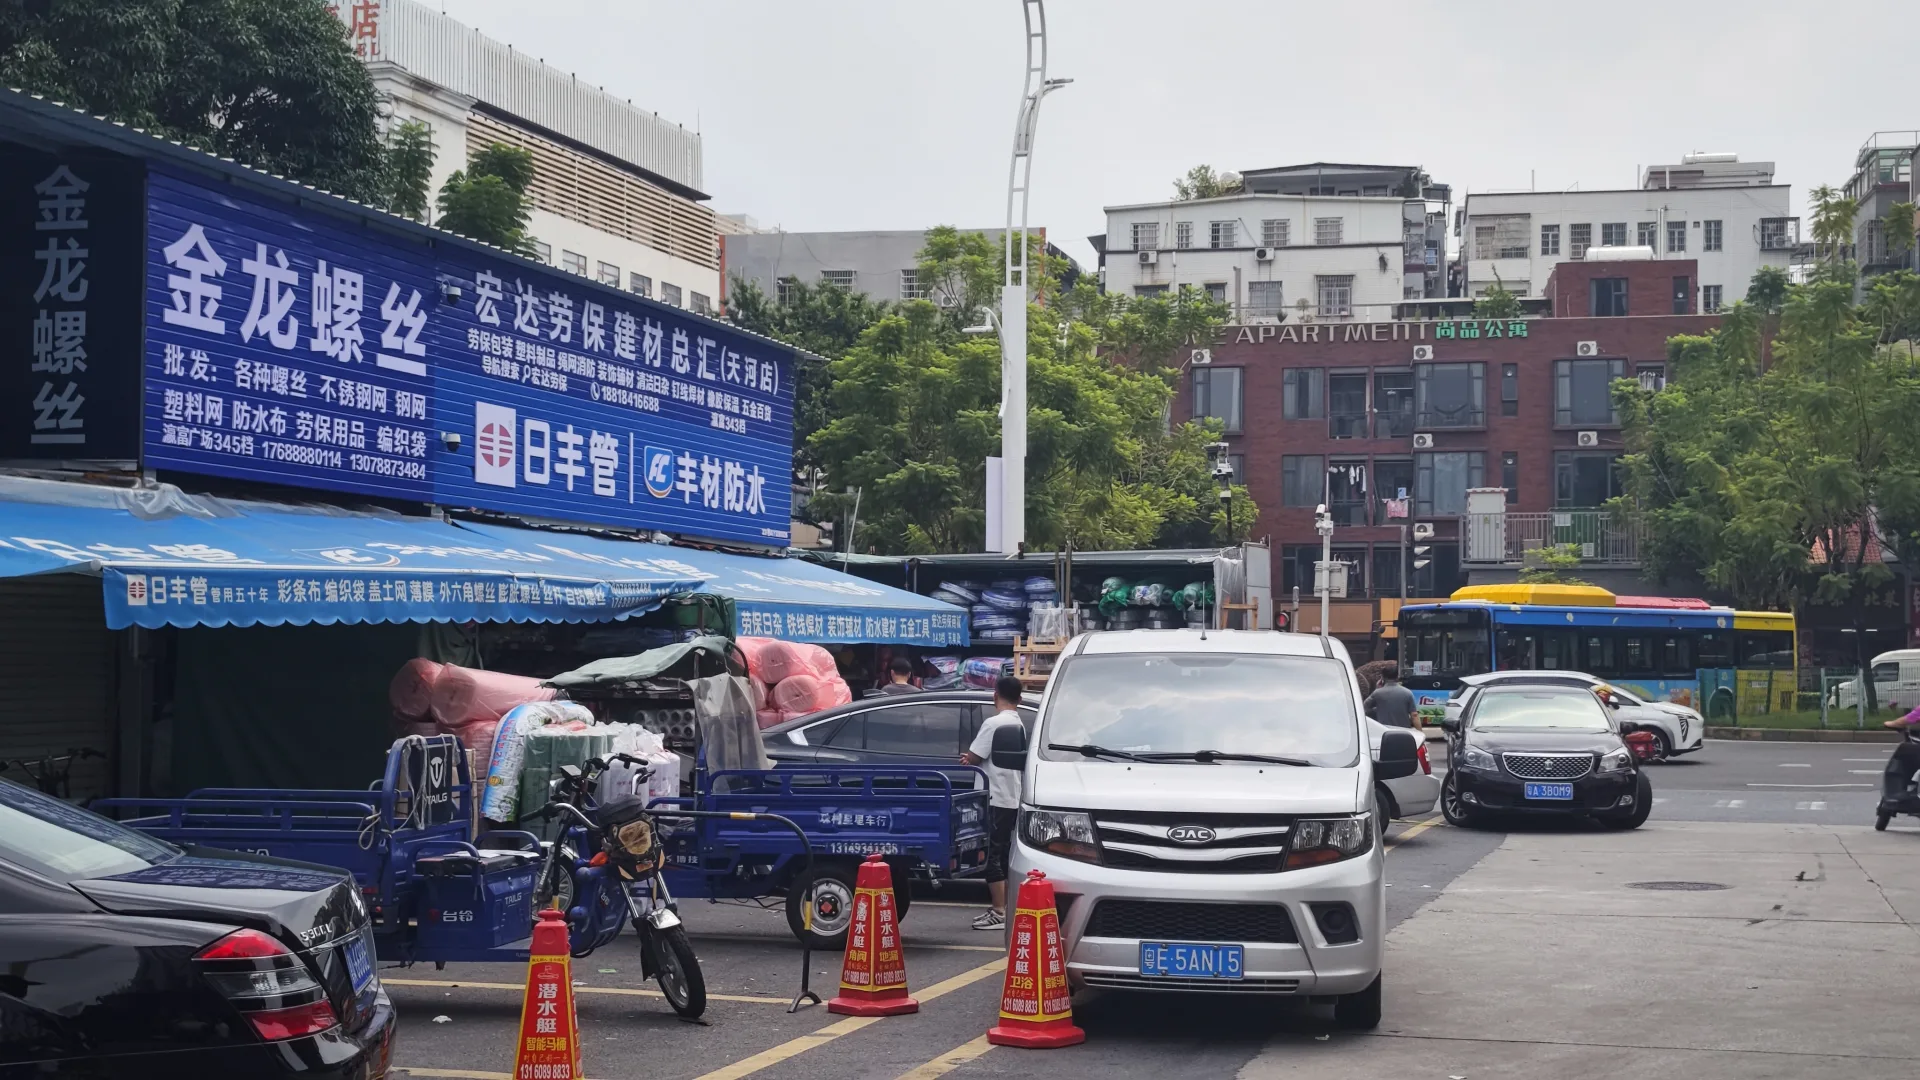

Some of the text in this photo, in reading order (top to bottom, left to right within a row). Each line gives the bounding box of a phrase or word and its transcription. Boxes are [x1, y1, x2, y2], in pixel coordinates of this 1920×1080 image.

[31, 164, 91, 444] 金龙螺丝
[163, 223, 427, 377] 金龙螺丝
[1435, 320, 1529, 339] 尚品公寓
[234, 357, 307, 398] 各种螺丝
[320, 375, 387, 413] 不锈钢网
[395, 390, 426, 420] 钢网
[467, 328, 513, 358] 劳保包装
[515, 340, 556, 369] 塑料制品
[557, 351, 596, 378] 绳网消防
[597, 360, 634, 388] 装饰辅材
[636, 370, 669, 396] 清洁日杂
[707, 389, 740, 414] 橡胶保温
[741, 399, 772, 422] 五金百货
[482, 355, 567, 392] 导航搜索 宏达劳保
[601, 385, 660, 412] 18818416688
[163, 388, 426, 457] 塑料网 防水布 劳保用品 编织袋
[162, 423, 425, 479] 瀛富广场345档 17688880114 13078873484
[524, 419, 618, 496] 日丰管
[675, 451, 766, 515] 丰材防水
[152, 575, 208, 605] 日丰管
[211, 587, 269, 603] 管用五十年
[277, 579, 321, 603] 彩条布
[325, 579, 365, 603] 编织袋
[368, 579, 407, 603] 盖土网
[409, 580, 435, 603] 薄膜
[439, 581, 495, 604] 外六角螺丝
[498, 583, 540, 604] 膨胀螺丝
[741, 610, 784, 636] 劳保日杂
[786, 612, 824, 638] 铁线焊材
[827, 614, 862, 639] 装饰辅材
[865, 616, 897, 639] 防水建材
[899, 617, 930, 639] 五金工具
[1174, 829, 1208, 839] JAC
[505, 892, 522, 905] TAILG
[443, 910, 474, 923] 台铃
[880, 909, 894, 949] 潜水艇
[848, 949, 867, 962] 角阀
[879, 950, 898, 962] 地漏
[1015, 931, 1031, 974] 潜水艇
[1046, 931, 1060, 974] 潜水艇
[1010, 975, 1033, 990] 卫浴
[536, 983, 558, 1033] 潜水艇
[526, 1037, 567, 1051] 智能马桶
[520, 1064, 570, 1079] 131 6089 8833
